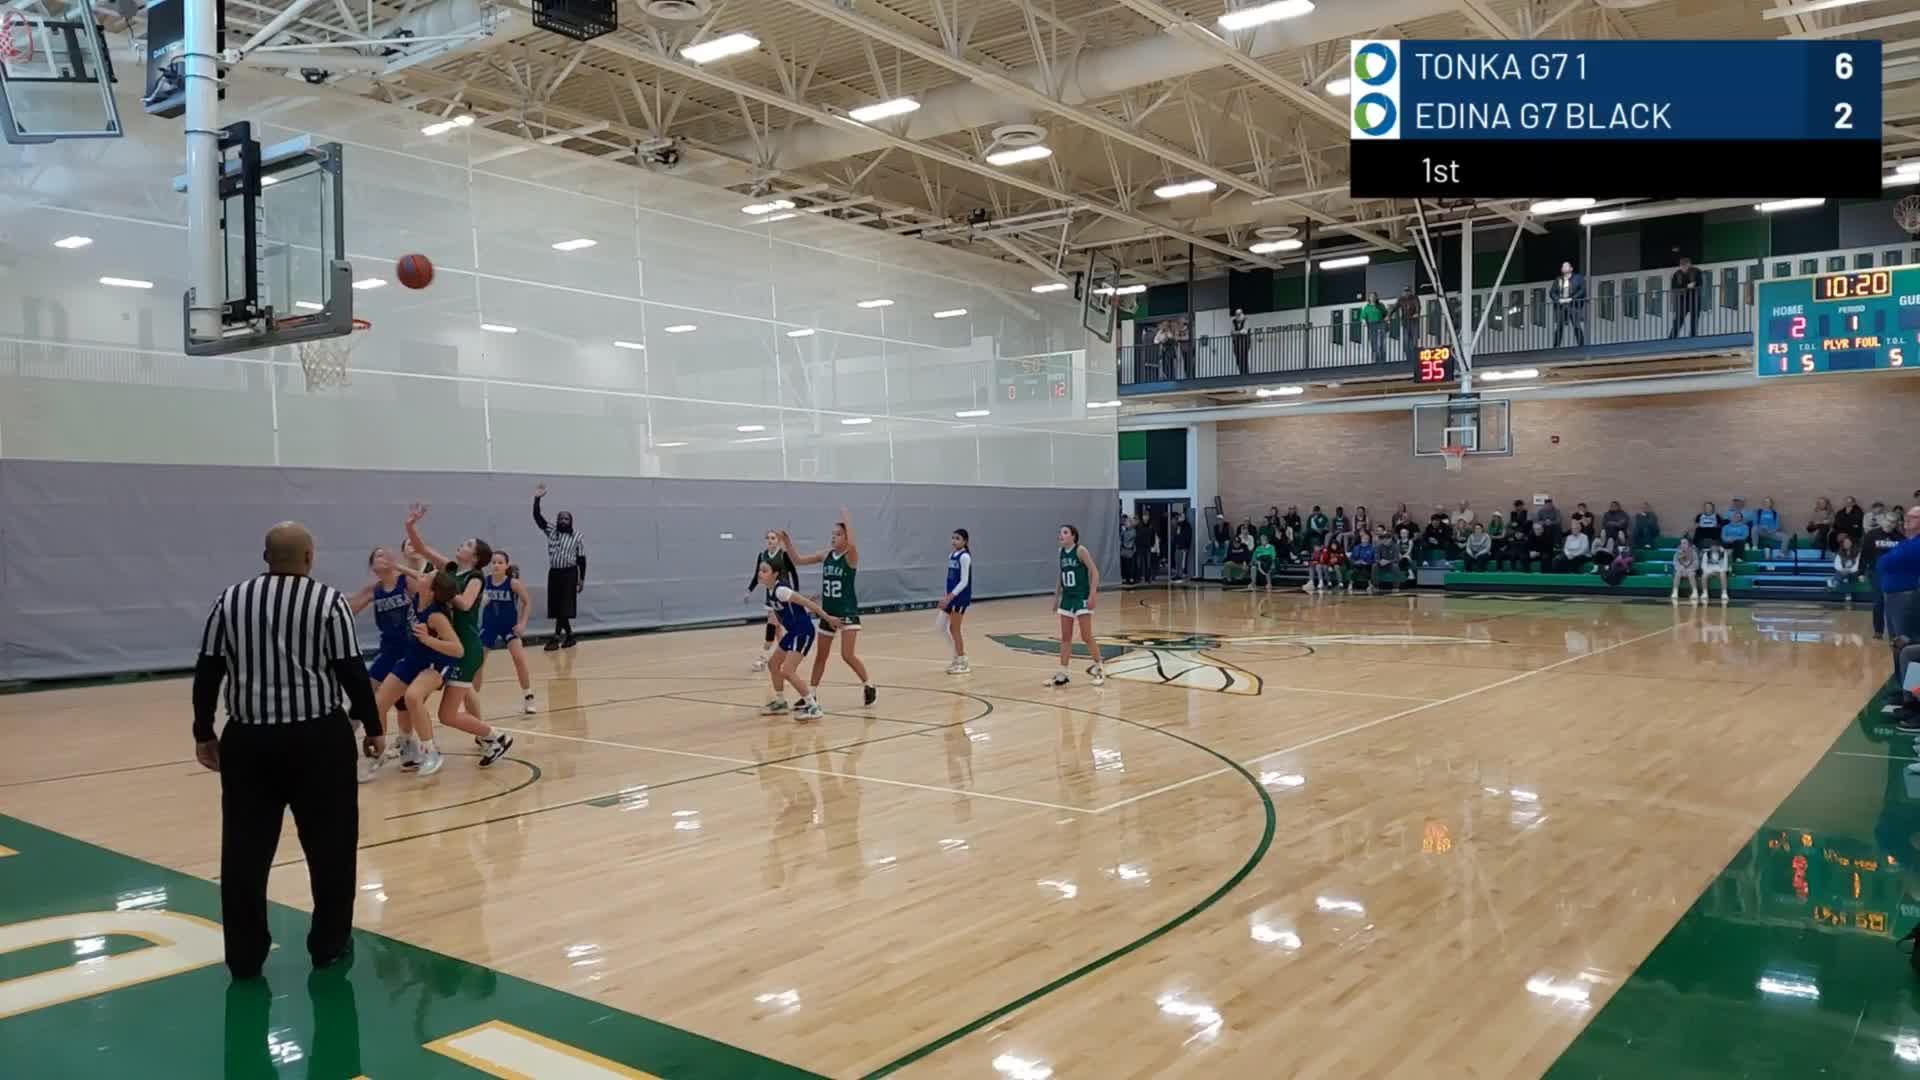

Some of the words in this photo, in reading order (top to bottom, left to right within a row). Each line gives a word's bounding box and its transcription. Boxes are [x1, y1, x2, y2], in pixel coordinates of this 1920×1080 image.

[1826, 273, 1888, 297] 10:20
[1772, 304, 1804, 316] HOME
[1838, 304, 1866, 313] PERIOD
[1791, 316, 1806, 338] 2
[1851, 315, 1858, 331] 1
[1823, 338, 1850, 351] PLYR
[1855, 336, 1881, 348] FOUL
[1420, 348, 1449, 360] 10:20
[1421, 360, 1445, 380] 35
[1062, 570, 1077, 588] 10
[822, 579, 843, 599] 32
